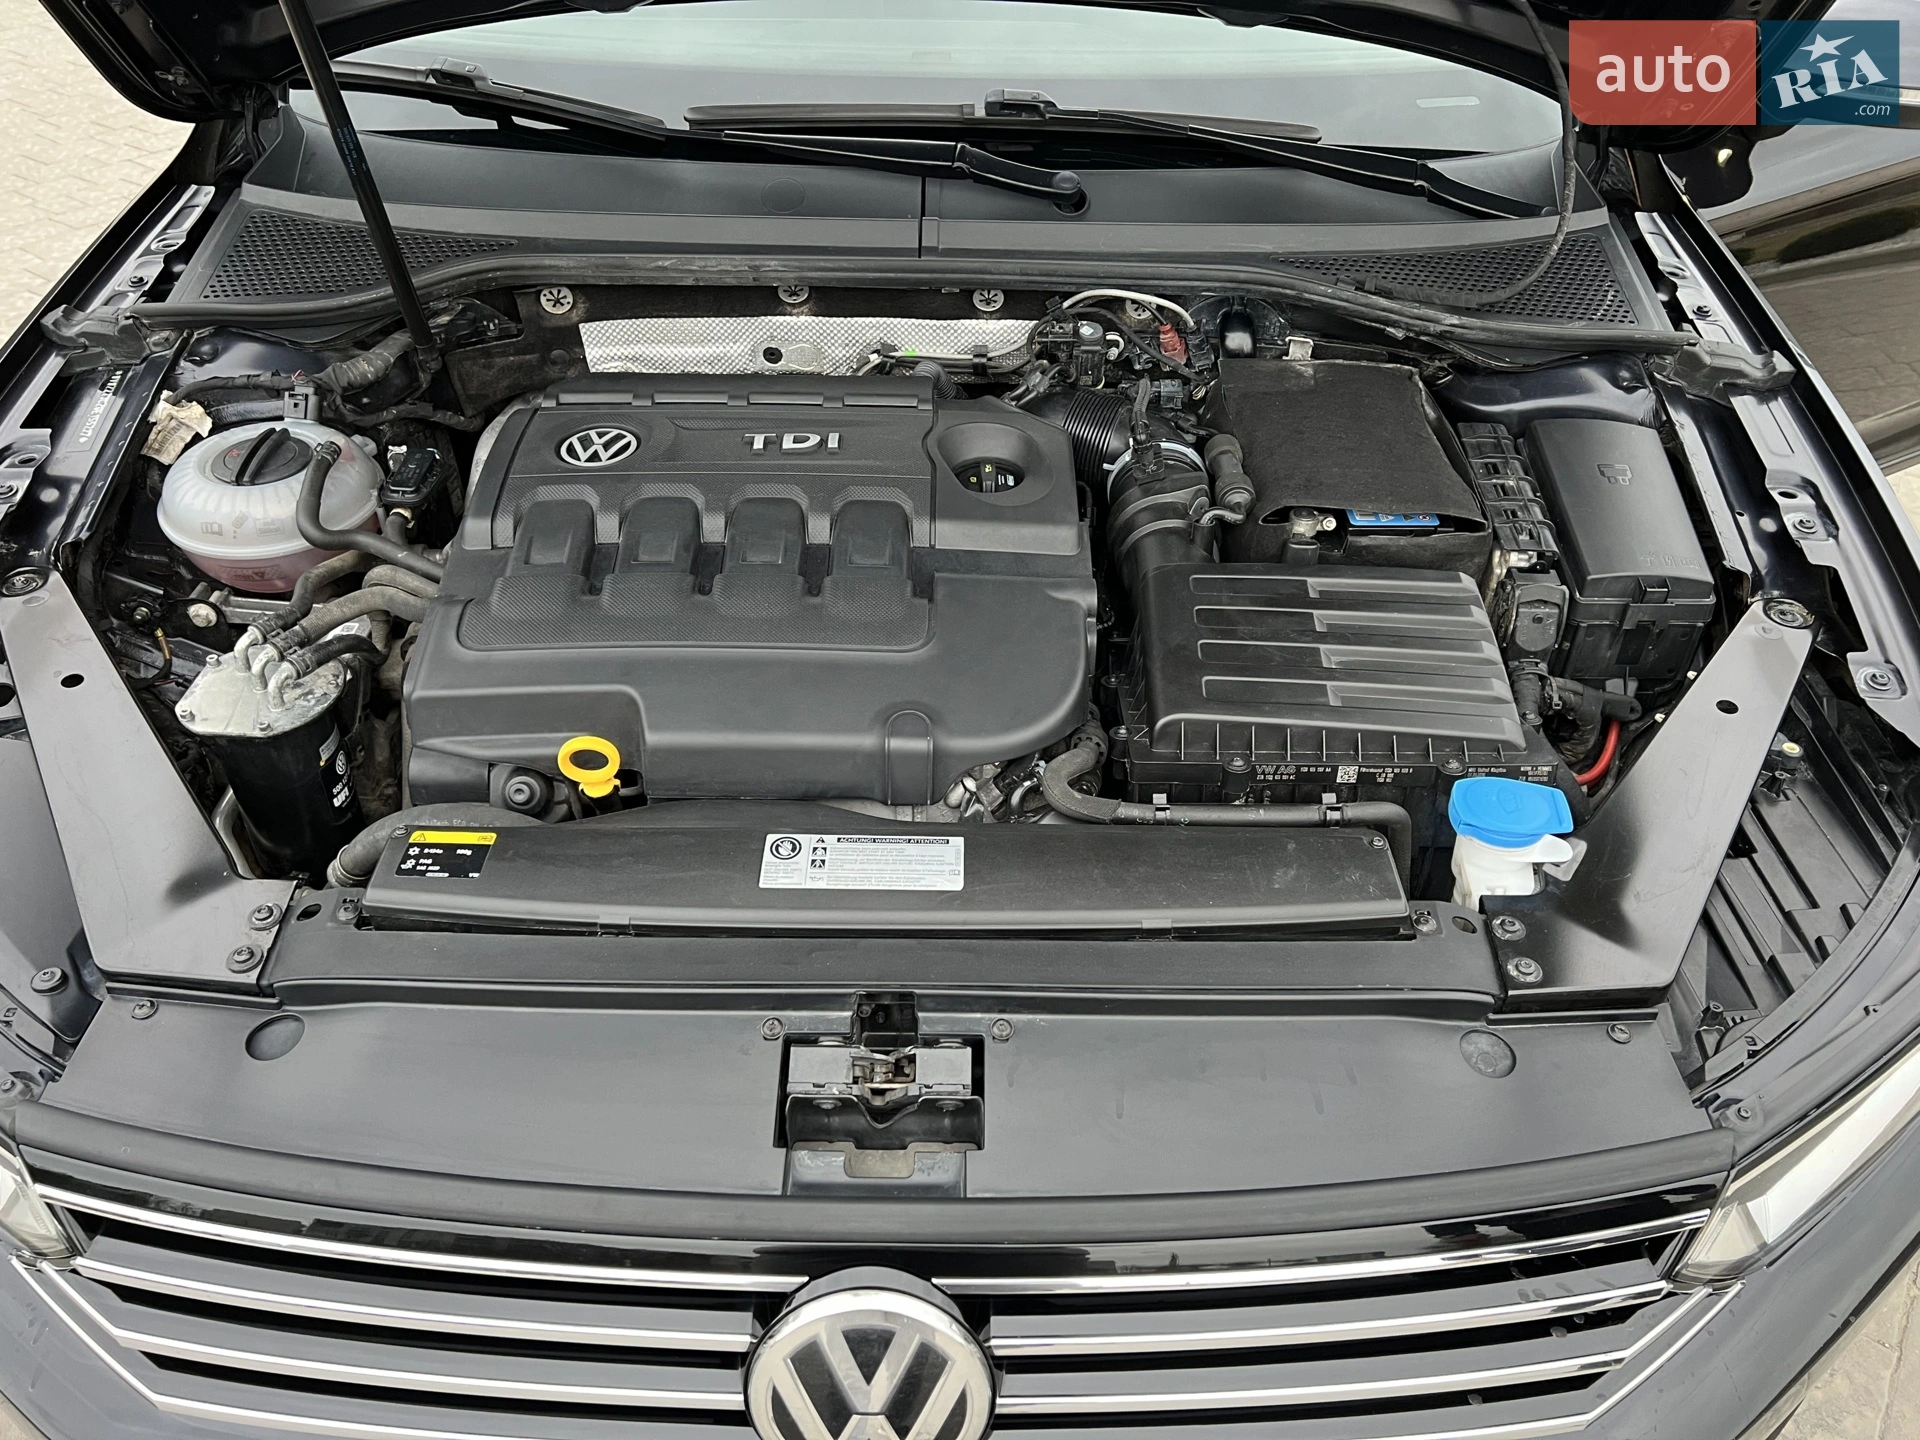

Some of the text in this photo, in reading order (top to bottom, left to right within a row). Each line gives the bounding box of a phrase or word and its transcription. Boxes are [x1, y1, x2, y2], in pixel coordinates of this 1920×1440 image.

[742, 432, 842, 454] TDI
[1255, 765, 1276, 774] VW
[1277, 765, 1296, 774] AG
